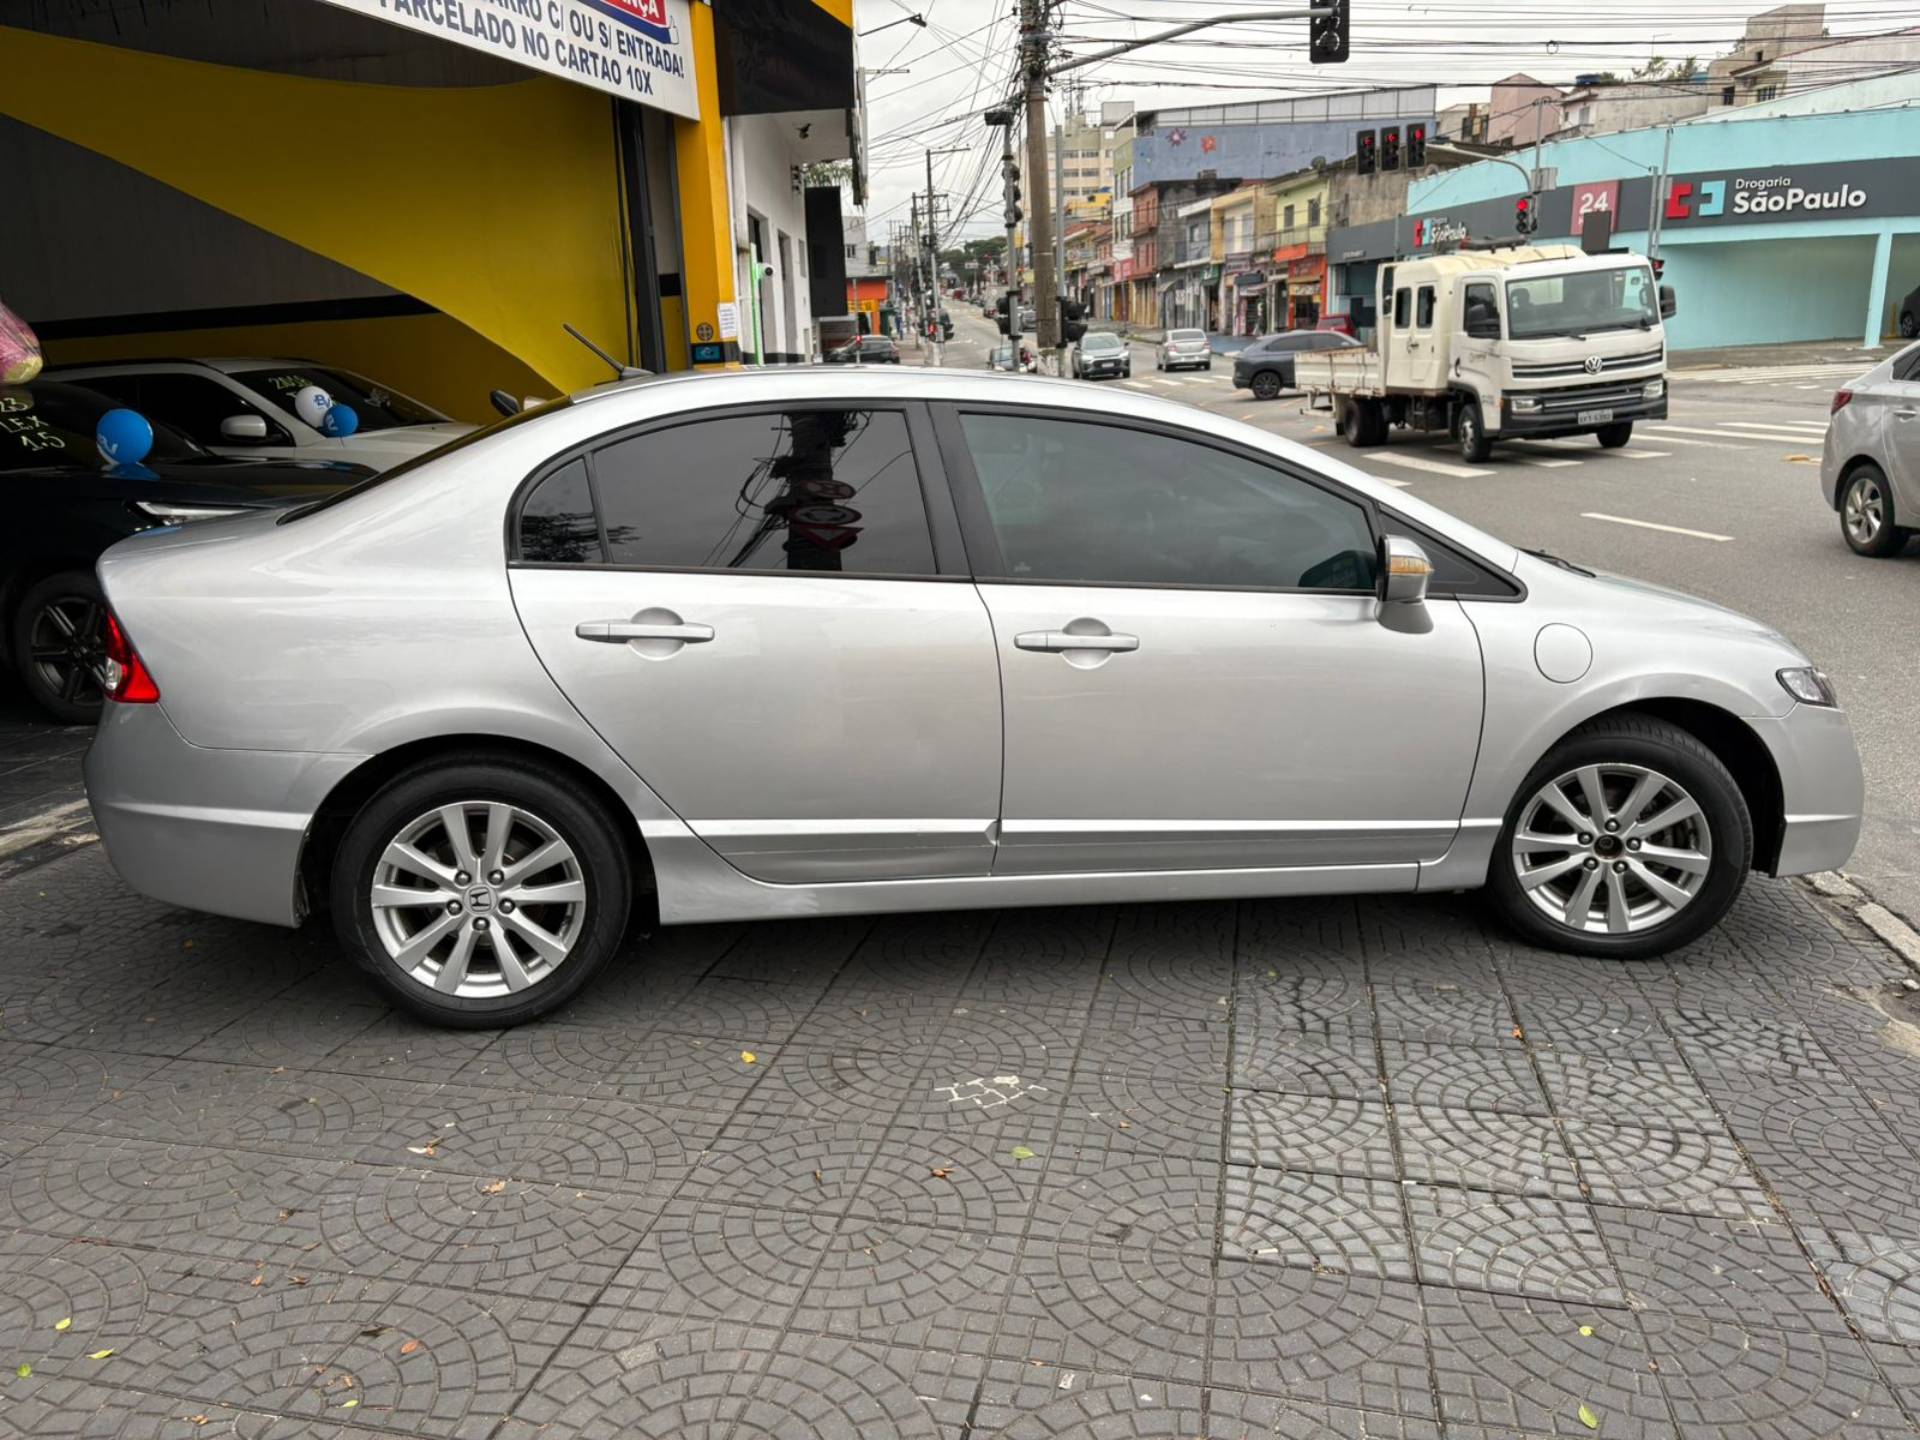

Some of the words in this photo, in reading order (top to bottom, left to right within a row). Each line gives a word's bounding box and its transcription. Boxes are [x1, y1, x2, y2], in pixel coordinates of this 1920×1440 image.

[380, 0, 517, 49] ARCELADO
[521, 24, 550, 61] NO
[555, 39, 622, 85] CARTAO
[627, 65, 654, 96] 10X
[548, 1, 565, 31] C/
[570, 10, 594, 42] OU
[599, 21, 613, 50] S/
[616, 29, 685, 79] ENTRADA!
[1735, 177, 1791, 190] Drogaria
[1579, 191, 1609, 211] 24
[1733, 184, 1867, 214] SãoPaulo
